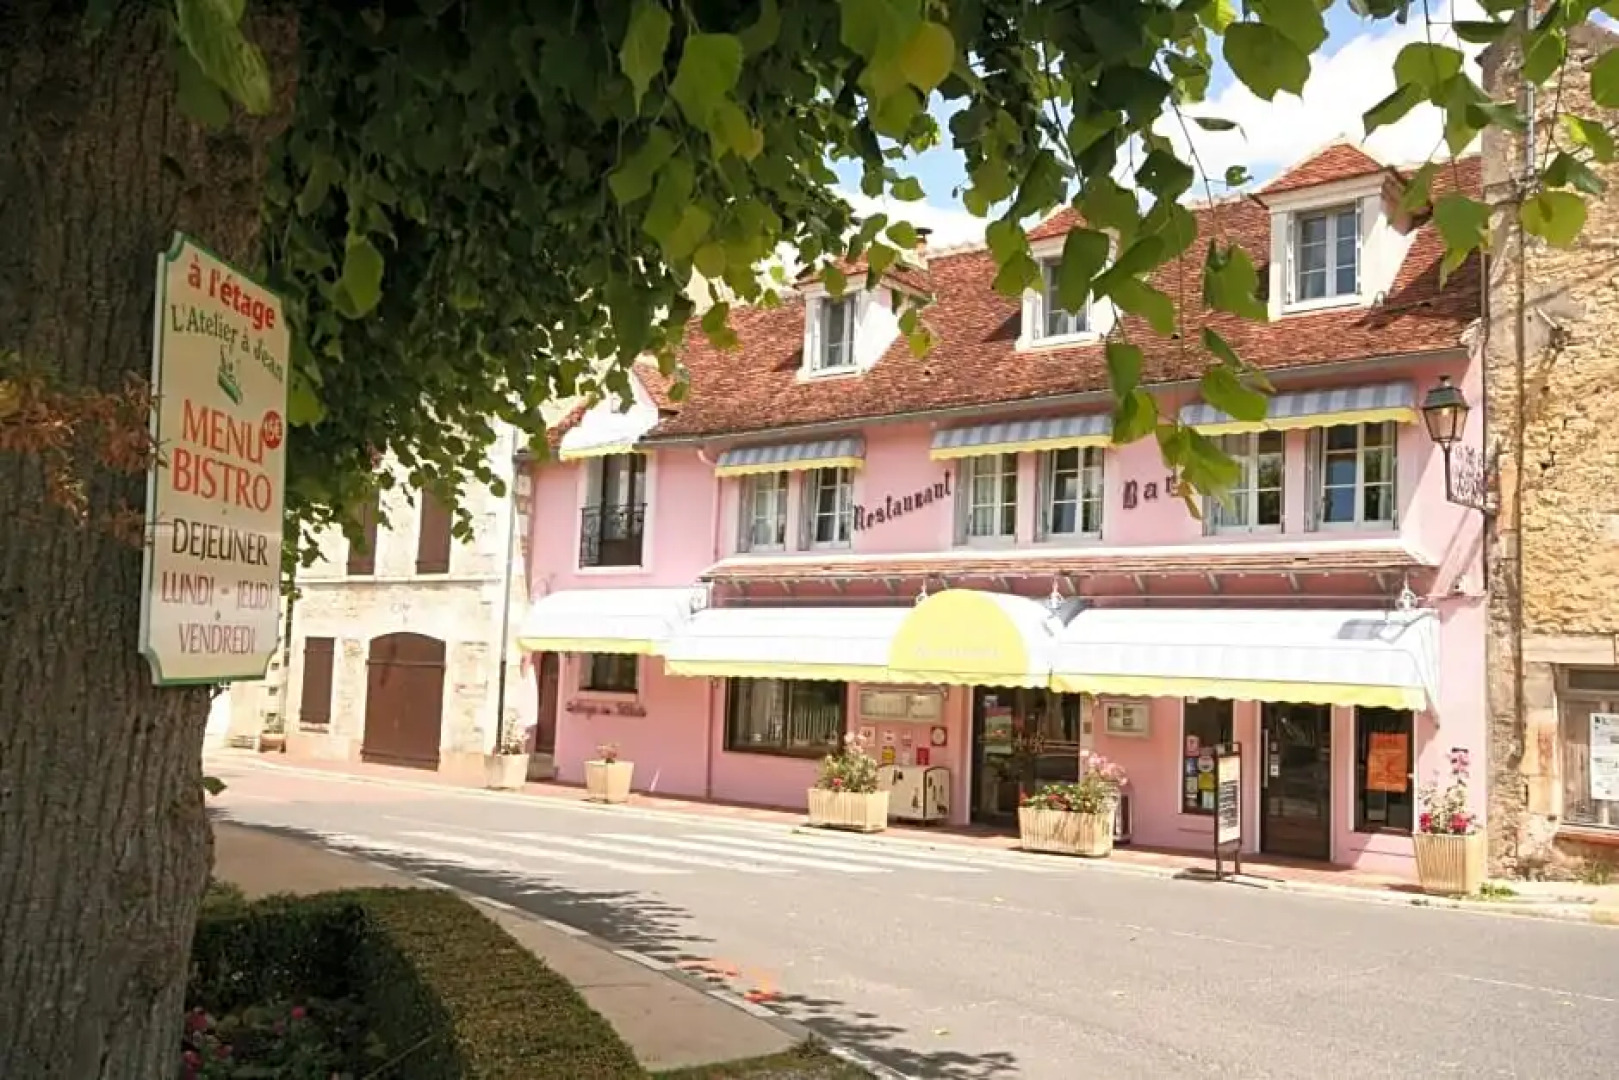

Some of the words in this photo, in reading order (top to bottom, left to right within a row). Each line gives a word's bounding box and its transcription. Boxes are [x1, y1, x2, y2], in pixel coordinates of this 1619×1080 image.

[187, 254, 202, 290] à
[209, 268, 276, 331] l'étage
[171, 303, 239, 344] L'Atelier
[183, 398, 263, 465] MENU
[172, 447, 272, 512] BISTRO
[853, 469, 952, 531] Restaurant
[171, 518, 268, 566] DEJEUNER
[161, 571, 215, 607] LUNDI
[236, 579, 274, 610] JEUDI
[178, 622, 256, 655] VENDREDI
